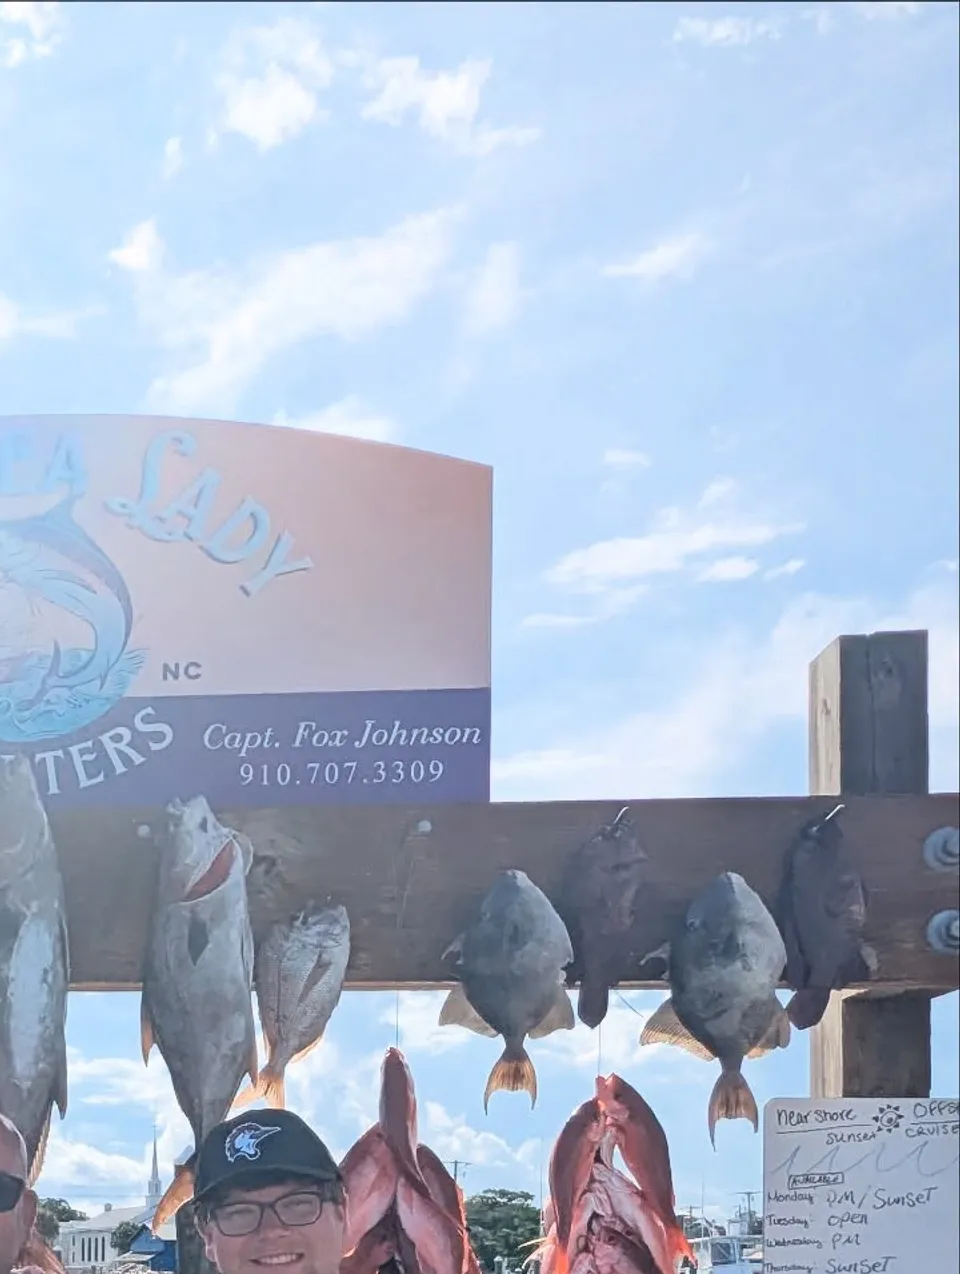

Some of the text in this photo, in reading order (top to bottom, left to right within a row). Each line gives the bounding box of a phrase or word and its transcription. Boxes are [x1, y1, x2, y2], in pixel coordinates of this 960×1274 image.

[103, 428, 314, 598] LADY
[161, 661, 203, 681] NC
[203, 719, 482, 757] Capt. Fox Johnson
[239, 759, 445, 787] 910.707.3309
